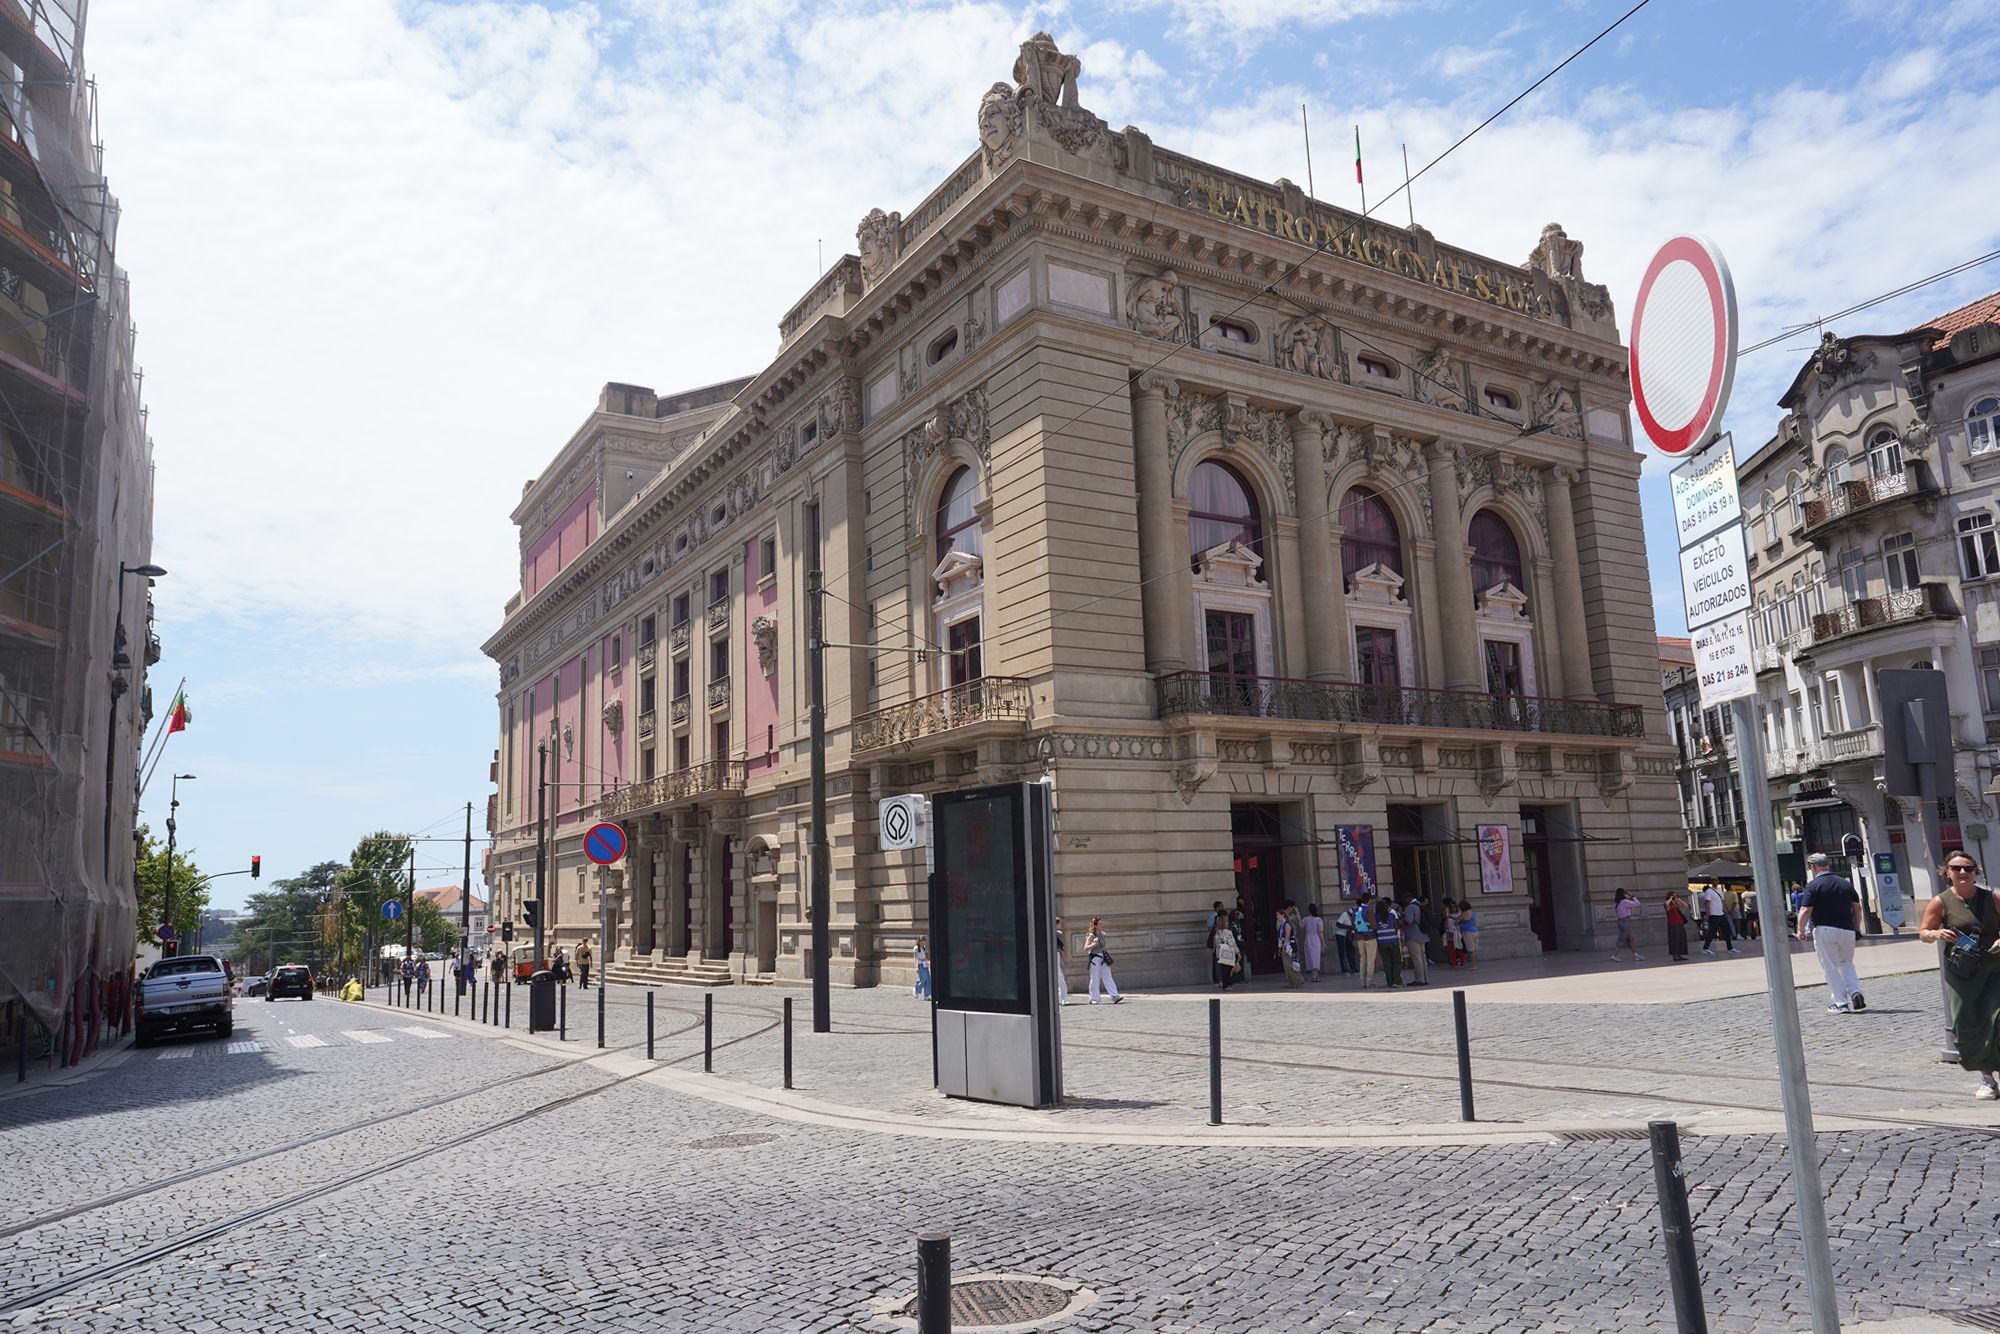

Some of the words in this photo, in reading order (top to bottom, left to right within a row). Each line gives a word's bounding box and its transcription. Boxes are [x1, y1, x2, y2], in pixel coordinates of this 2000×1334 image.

[1187, 180, 1317, 245] TEATRO
[1318, 223, 1469, 295] NACIONAL
[1675, 478, 1690, 496] AOS
[1690, 455, 1724, 487] SÁBADOS
[1725, 451, 1731, 464] E
[1686, 477, 1723, 510] DOMINGOS
[1682, 514, 1697, 533] DAS
[1719, 496, 1727, 510] 19
[1693, 544, 1725, 570] EXCETO
[1693, 564, 1734, 593] VEÍCULOS
[1689, 583, 1747, 619] AUTORIZADOS
[1702, 672, 1715, 687] DAS
[1716, 669, 1726, 683] 21
[1734, 663, 1749, 677] 24h
